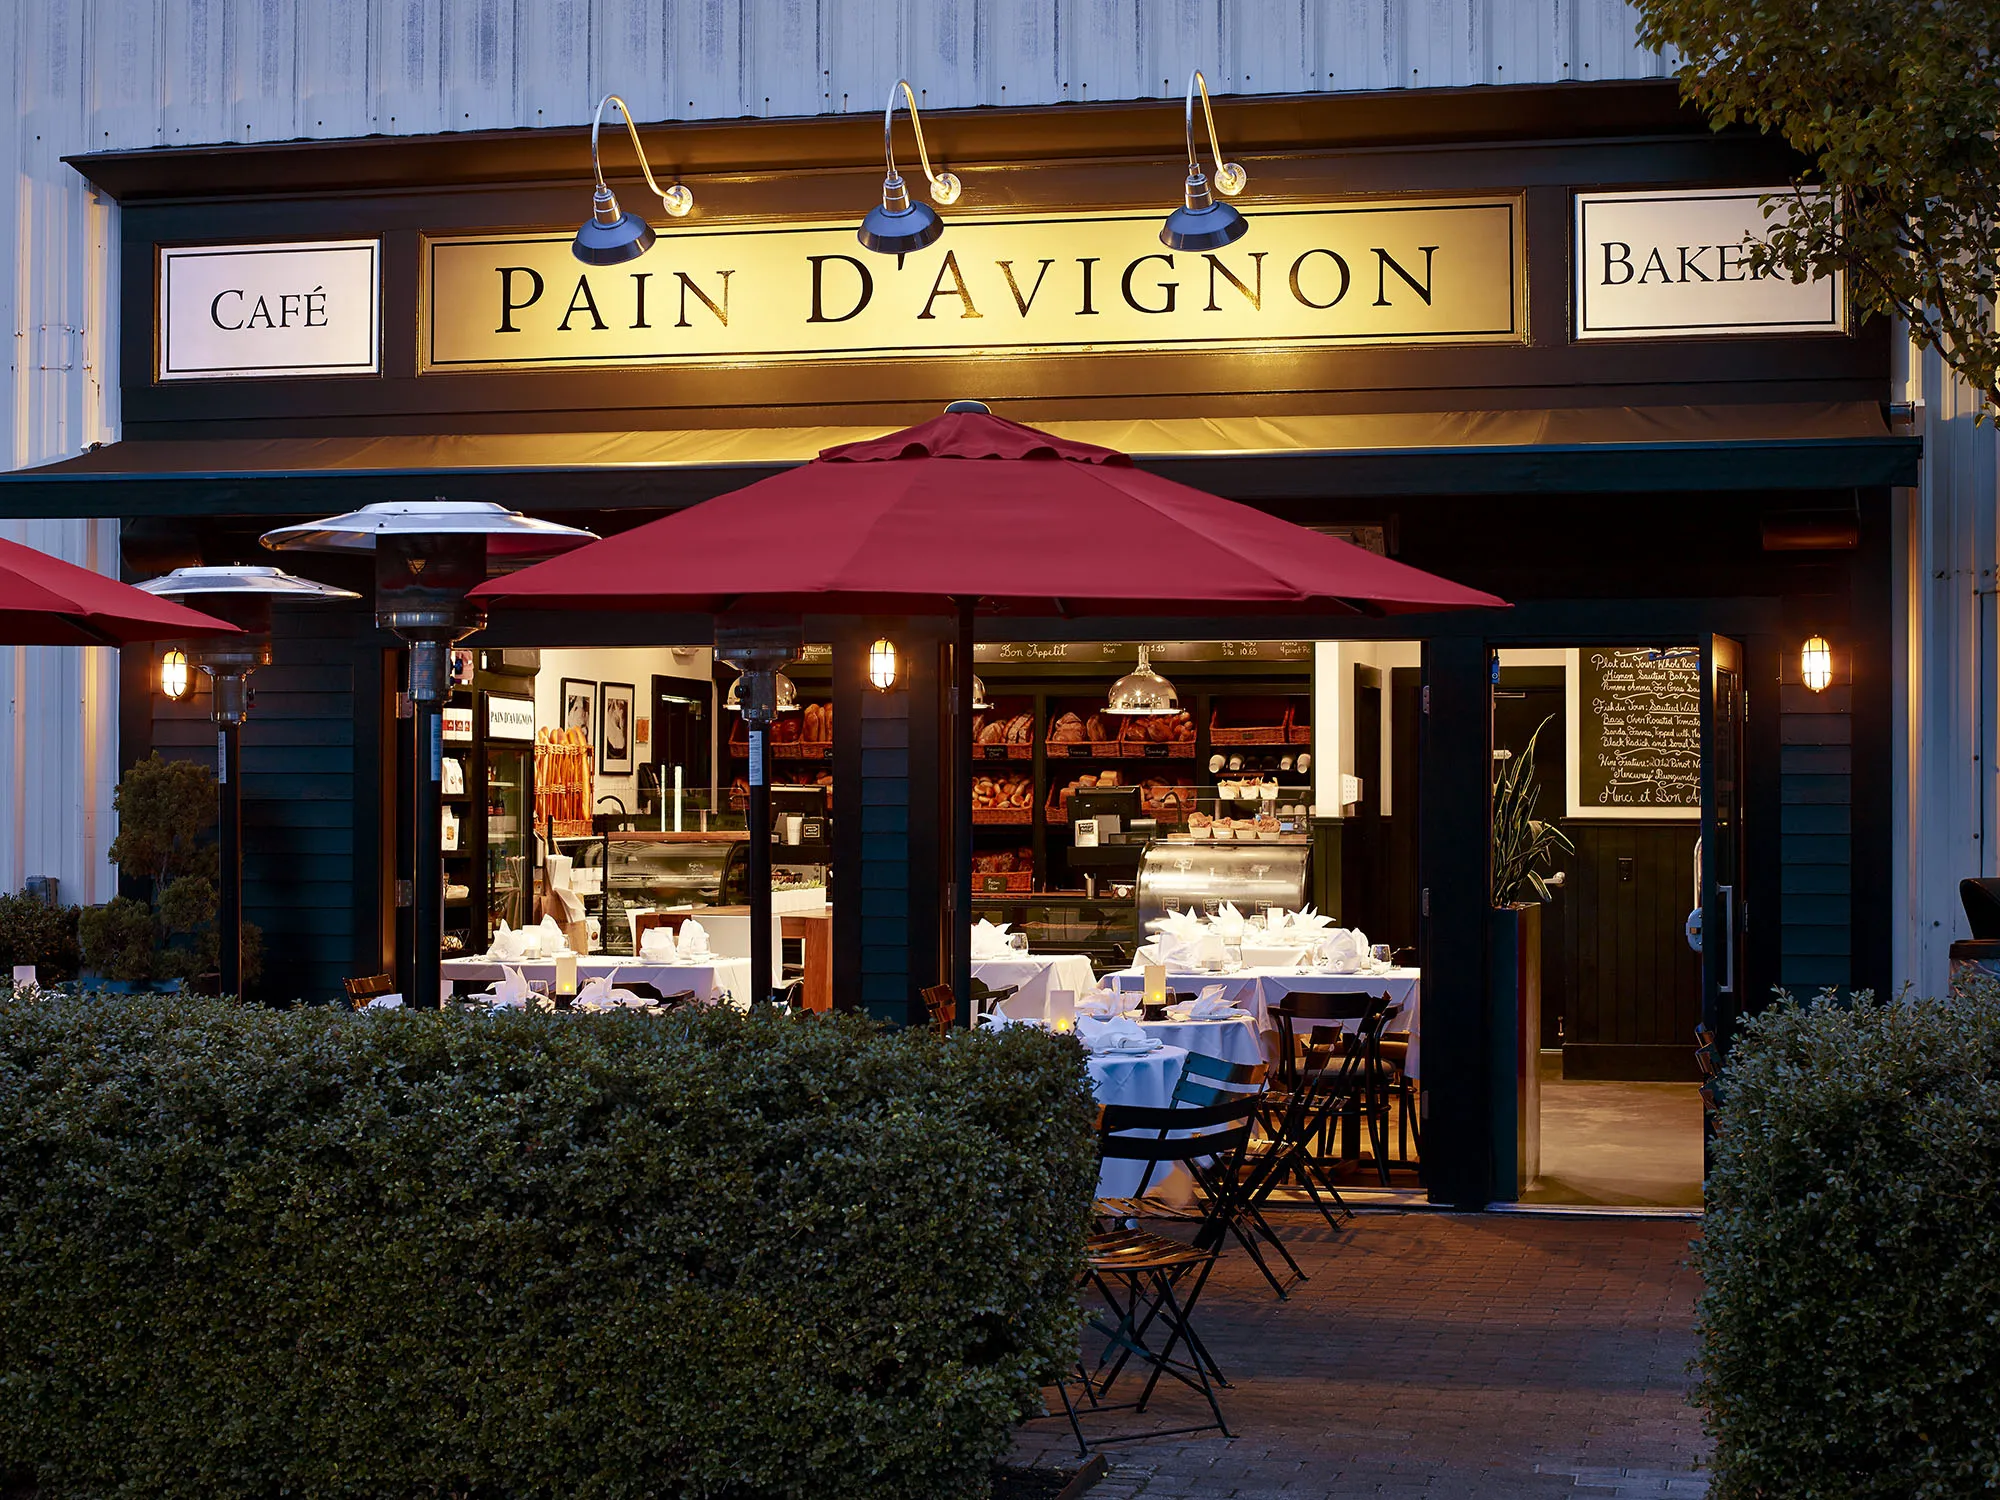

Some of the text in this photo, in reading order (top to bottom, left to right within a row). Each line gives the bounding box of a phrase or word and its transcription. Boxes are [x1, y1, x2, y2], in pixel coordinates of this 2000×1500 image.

[1600, 241, 1790, 286] BAKER
[495, 245, 1439, 334] PAIN D'AVIGNON
[210, 285, 328, 330] CAFÉ
[1000, 643, 1024, 658] Bon
[1620, 658, 1634, 668] du
[1615, 702, 1626, 711] du
[1599, 785, 1634, 803] Merci
[1638, 788, 1651, 802] et
[1655, 786, 1681, 803] Bon
